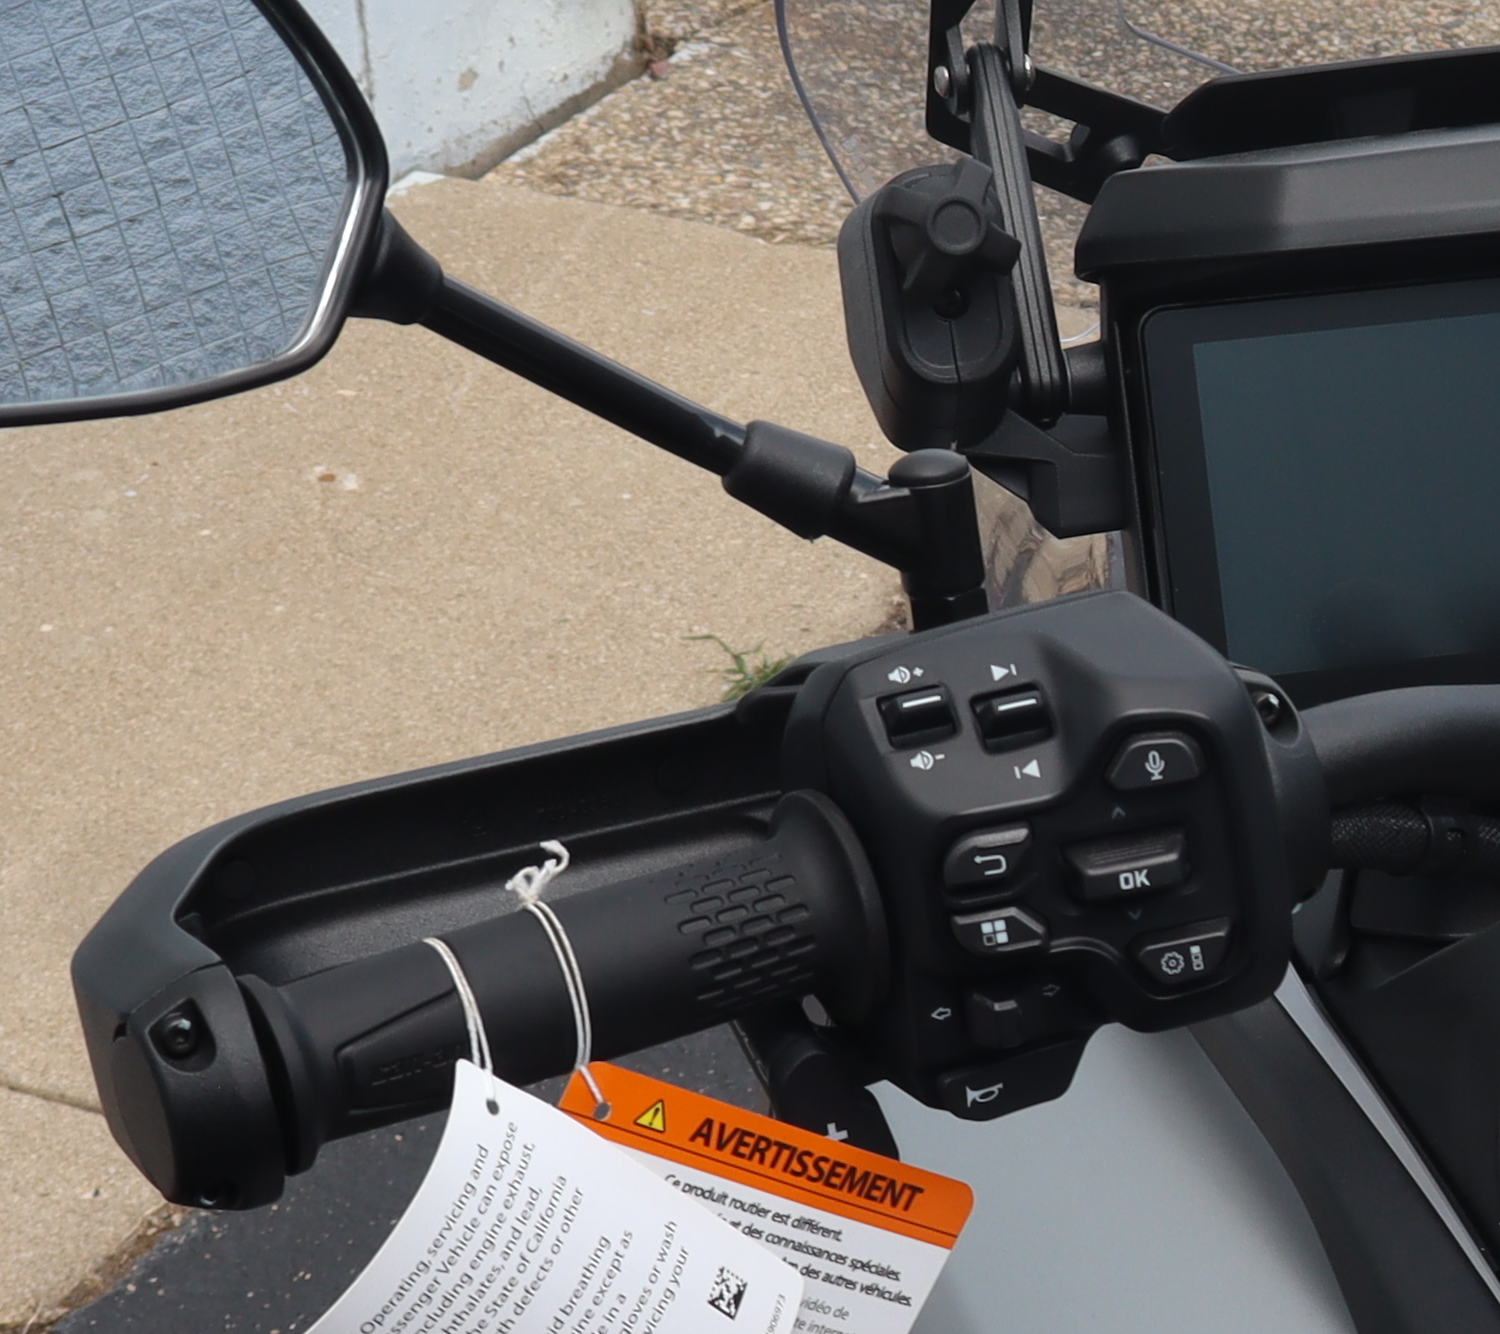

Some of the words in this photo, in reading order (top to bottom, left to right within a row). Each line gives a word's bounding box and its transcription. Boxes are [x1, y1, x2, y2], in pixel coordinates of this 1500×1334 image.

[1119, 868, 1151, 891] OK
[435, 1217, 481, 1275] Vehicle
[477, 1184, 498, 1215] can
[492, 1121, 518, 1182] expose
[687, 1116, 927, 1214] AVERTISSEMENT
[359, 1260, 432, 1334] Operating,
[427, 1181, 476, 1257] servicing
[471, 1143, 489, 1181] and
[469, 1212, 507, 1271] engine
[483, 1276, 519, 1318] State
[516, 1252, 531, 1275] of
[525, 1175, 567, 1254] California
[500, 1225, 523, 1262] and
[514, 1186, 543, 1227] lead,
[680, 1182, 730, 1206] produit
[728, 1197, 773, 1219] routier
[770, 1211, 792, 1226] est
[790, 1216, 843, 1243] différent.
[512, 1258, 554, 1317] defects
[550, 1235, 564, 1256] or
[560, 1187, 584, 1234] other
[558, 1235, 612, 1317] breathing
[591, 1250, 625, 1307] except
[620, 1230, 633, 1250] as
[648, 1264, 661, 1285] or
[656, 1220, 678, 1263] wash
[668, 1245, 690, 1288] your
[741, 1222, 765, 1240] des
[764, 1232, 849, 1266] connaissances
[847, 1258, 901, 1282] spéciales.
[798, 1263, 823, 1280] des
[820, 1272, 859, 1291] autres
[859, 1282, 912, 1308] véhicules.
[601, 1306, 620, 1324] in
[616, 1293, 627, 1305] a
